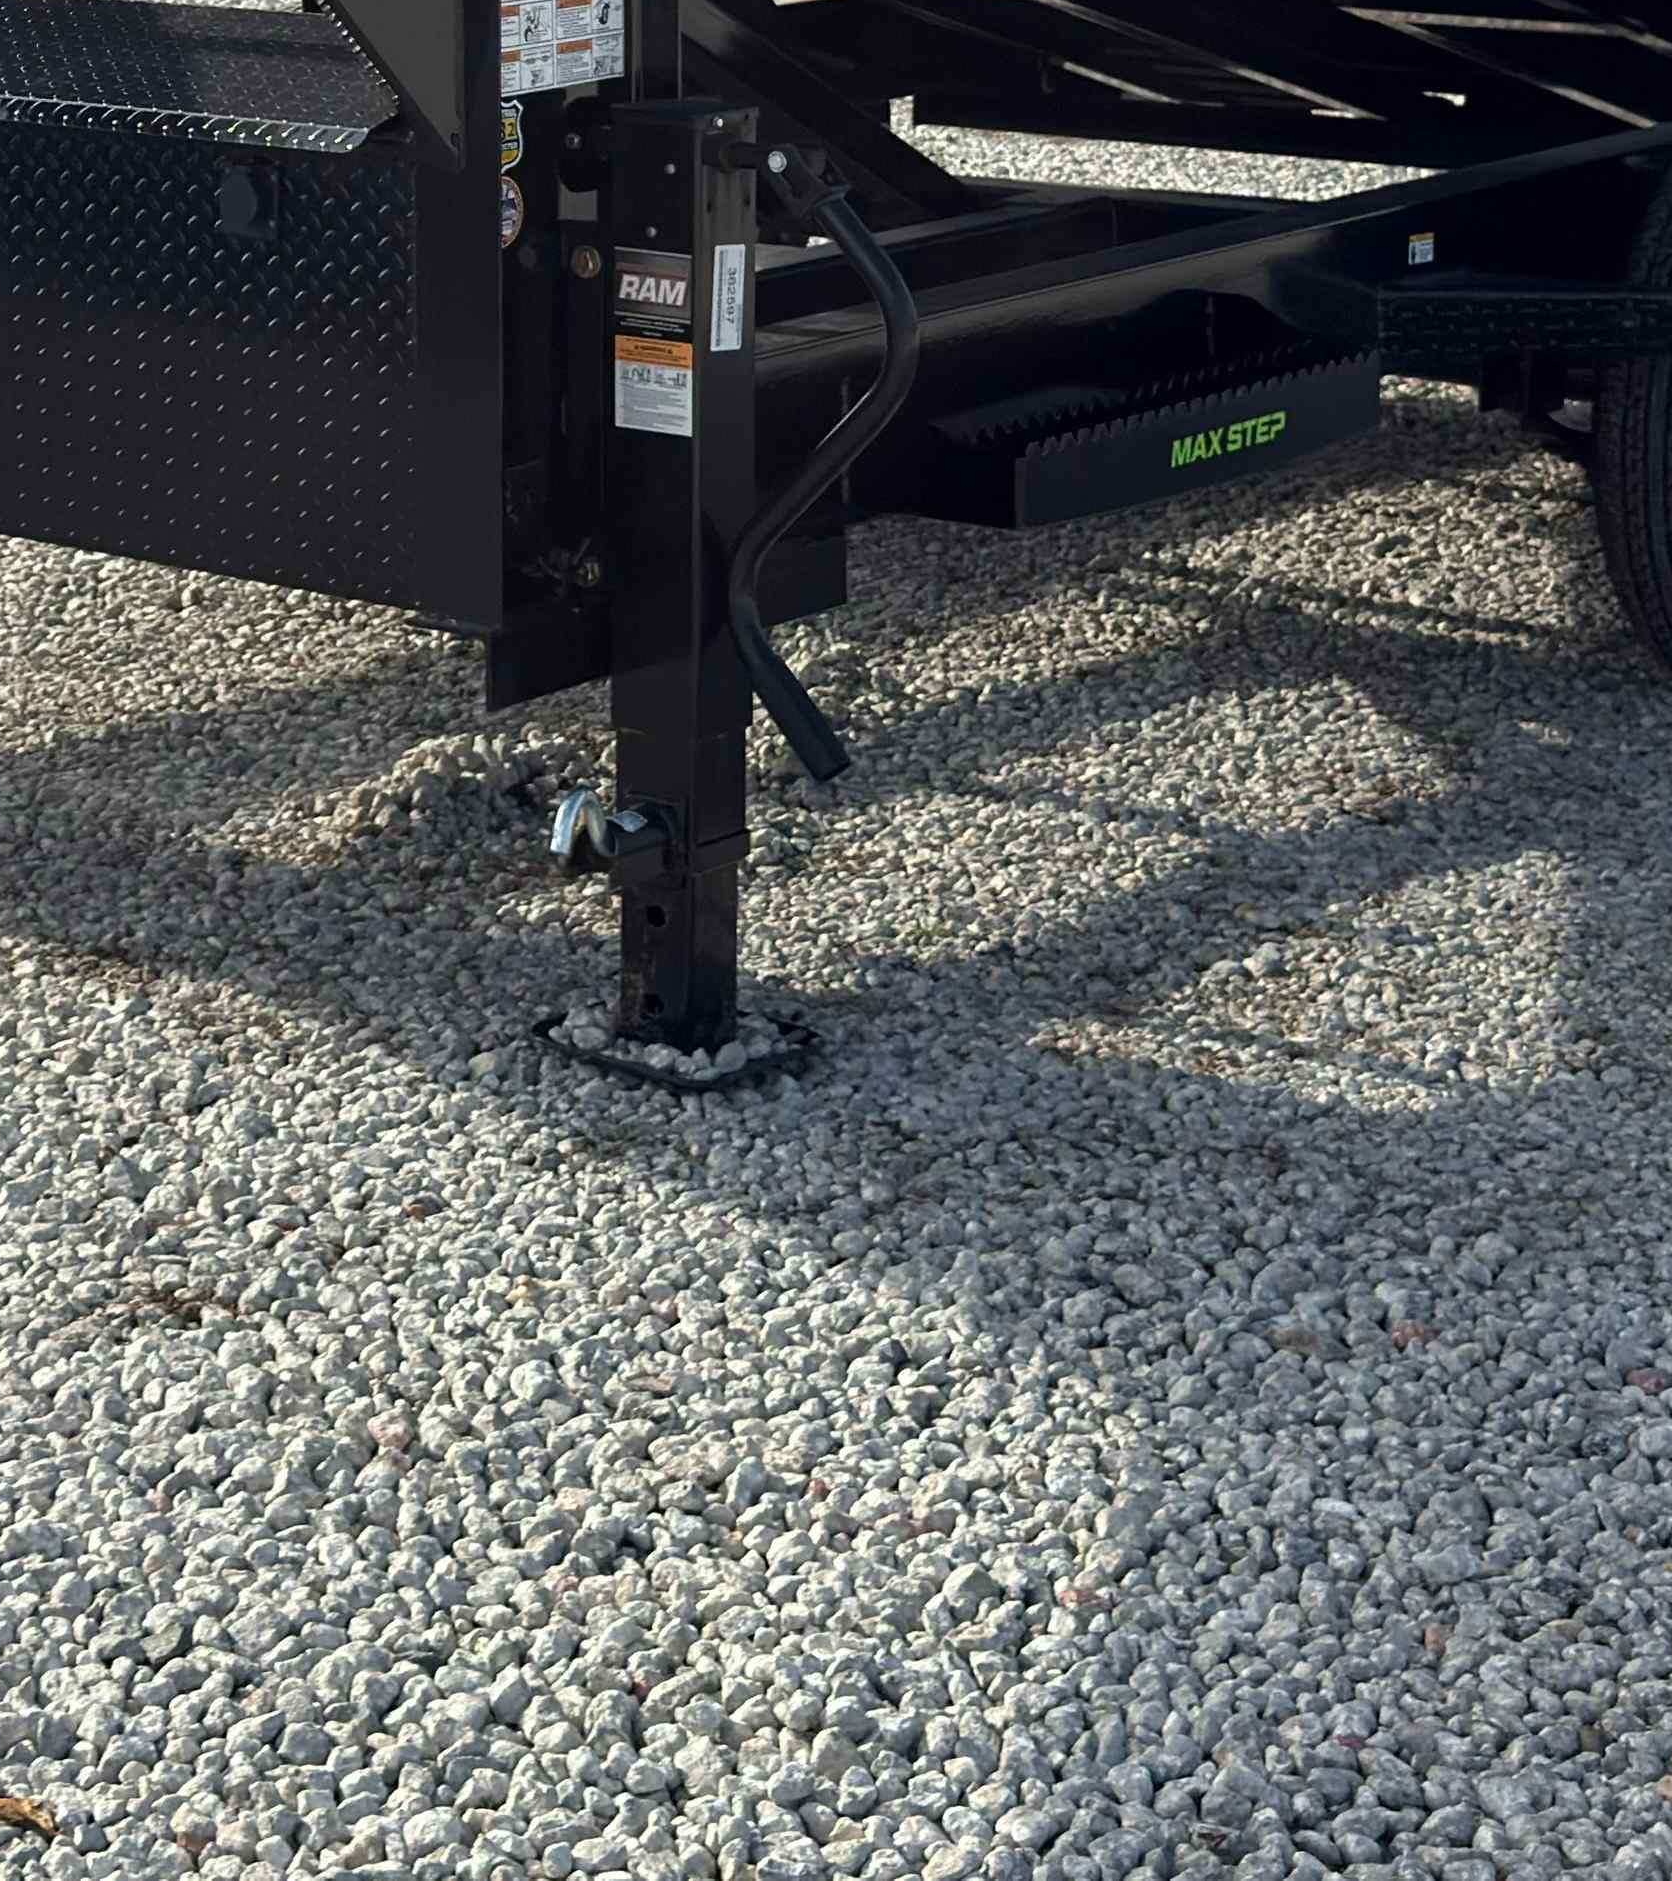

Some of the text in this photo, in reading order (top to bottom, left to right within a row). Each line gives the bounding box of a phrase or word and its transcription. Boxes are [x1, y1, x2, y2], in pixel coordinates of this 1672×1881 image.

[618, 273, 688, 307] RAM
[1170, 410, 1287, 468] MAX STEP
